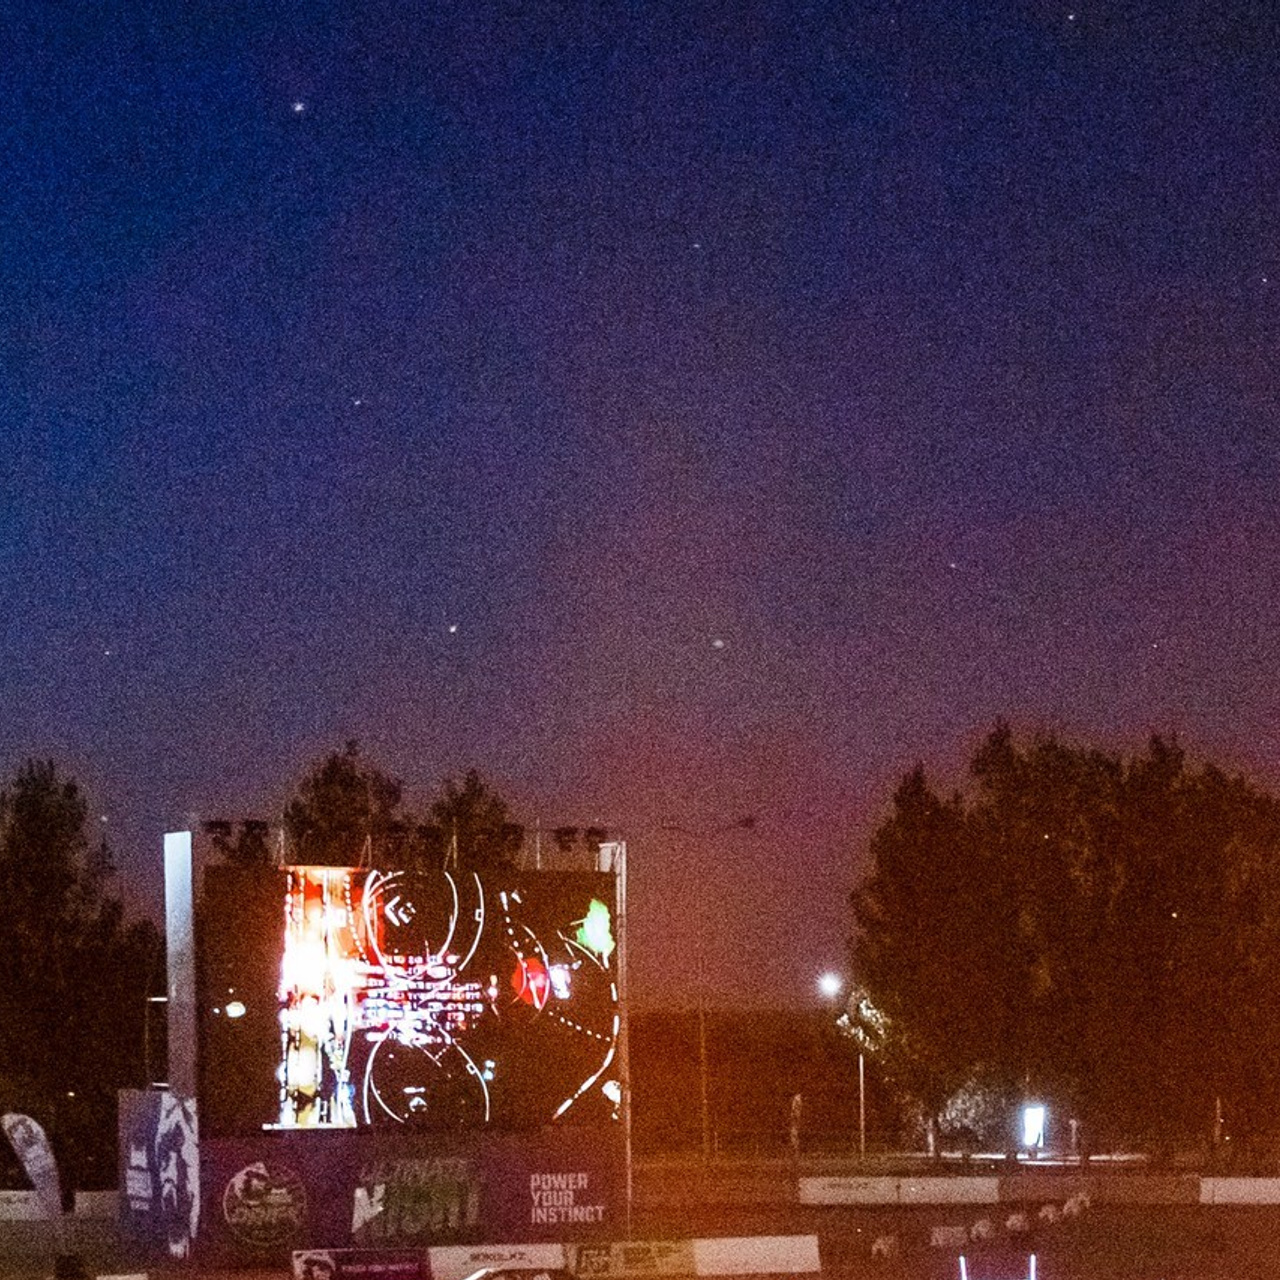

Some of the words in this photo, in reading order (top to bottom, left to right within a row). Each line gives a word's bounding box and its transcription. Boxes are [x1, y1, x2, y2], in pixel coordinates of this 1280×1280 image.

[530, 1173, 589, 1190] POWER
[530, 1191, 575, 1207] YOUR
[531, 1206, 605, 1224] INSTINCT
